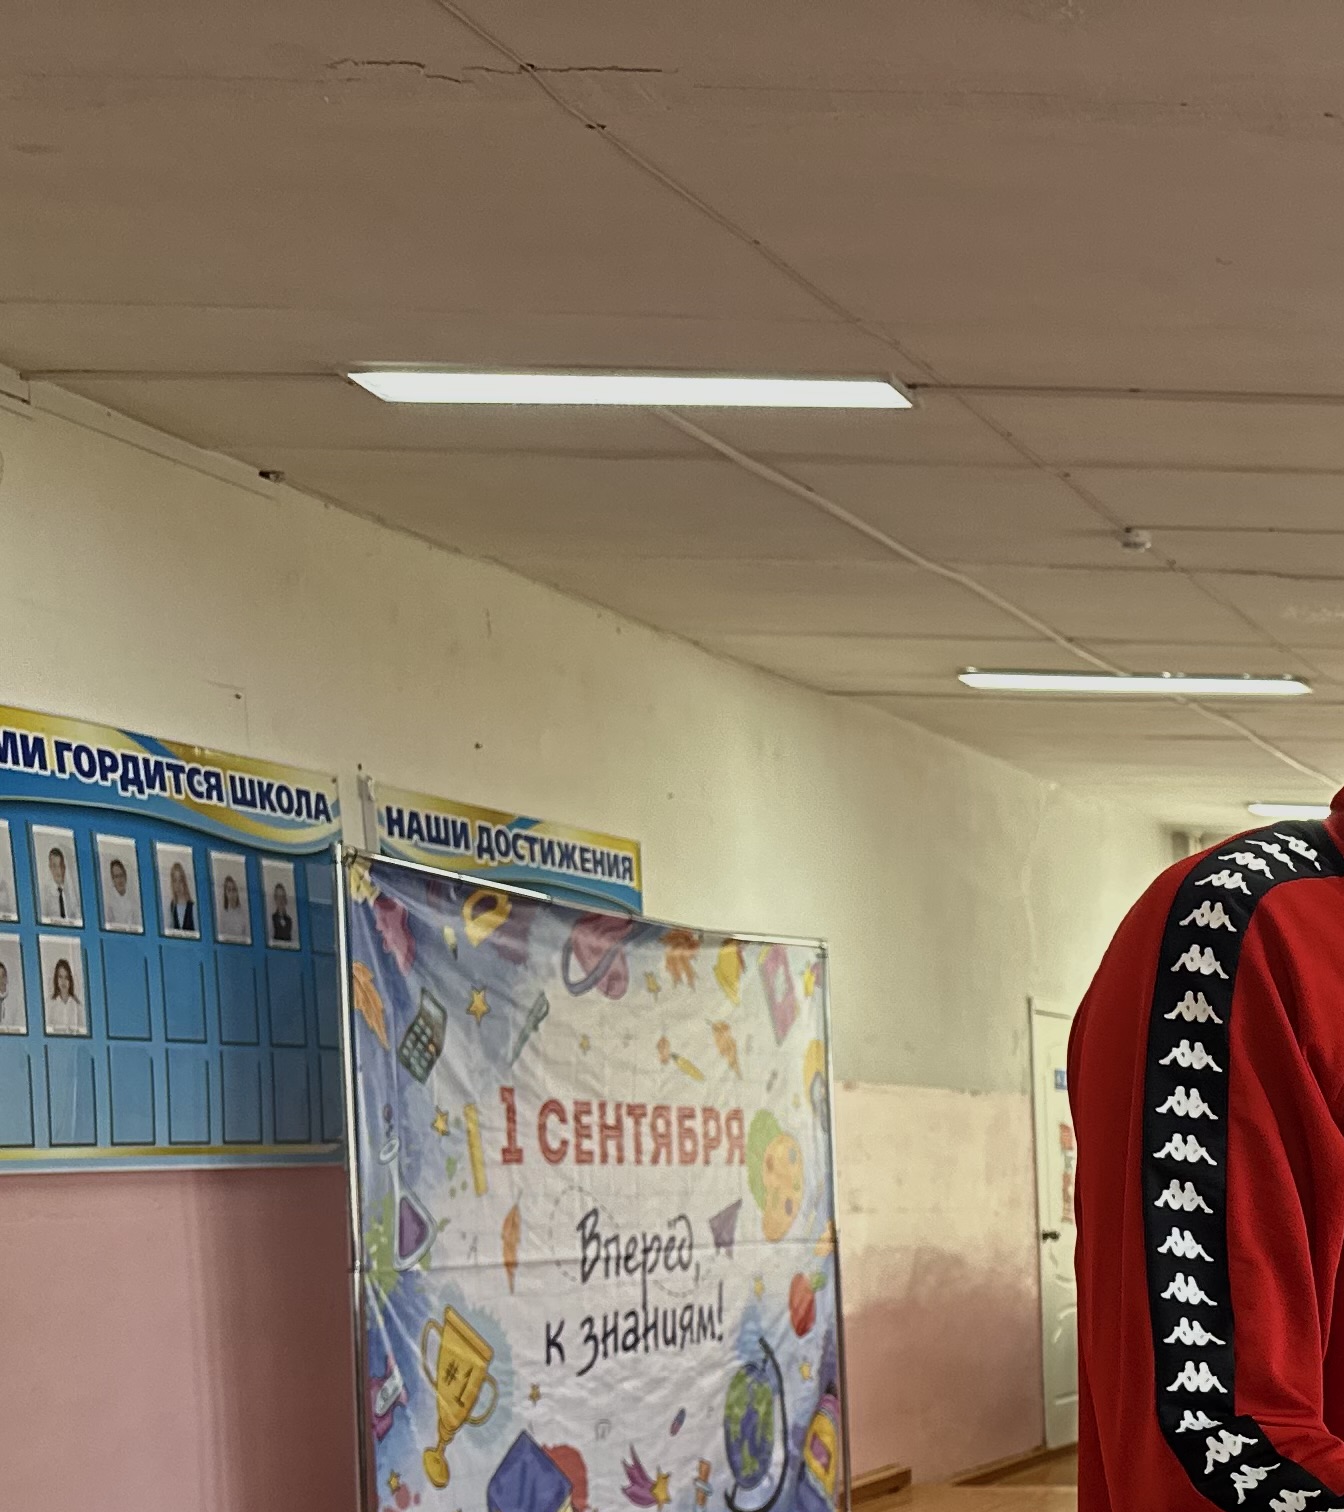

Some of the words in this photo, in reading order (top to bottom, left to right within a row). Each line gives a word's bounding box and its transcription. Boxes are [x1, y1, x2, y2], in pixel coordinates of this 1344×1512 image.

[54, 741, 225, 803] ГОРДИТСЯ
[229, 774, 332, 823] ШКОЛА
[385, 805, 471, 852] НАШИ
[476, 823, 635, 883] ДОСТИЖЕНИЯ
[500, 1086, 523, 1166] 1
[537, 1102, 747, 1168] СЕНТЯБРЯ
[576, 1208, 701, 1307] Вперёд,
[545, 1317, 566, 1366] к
[576, 1280, 726, 1378] знаниям!
